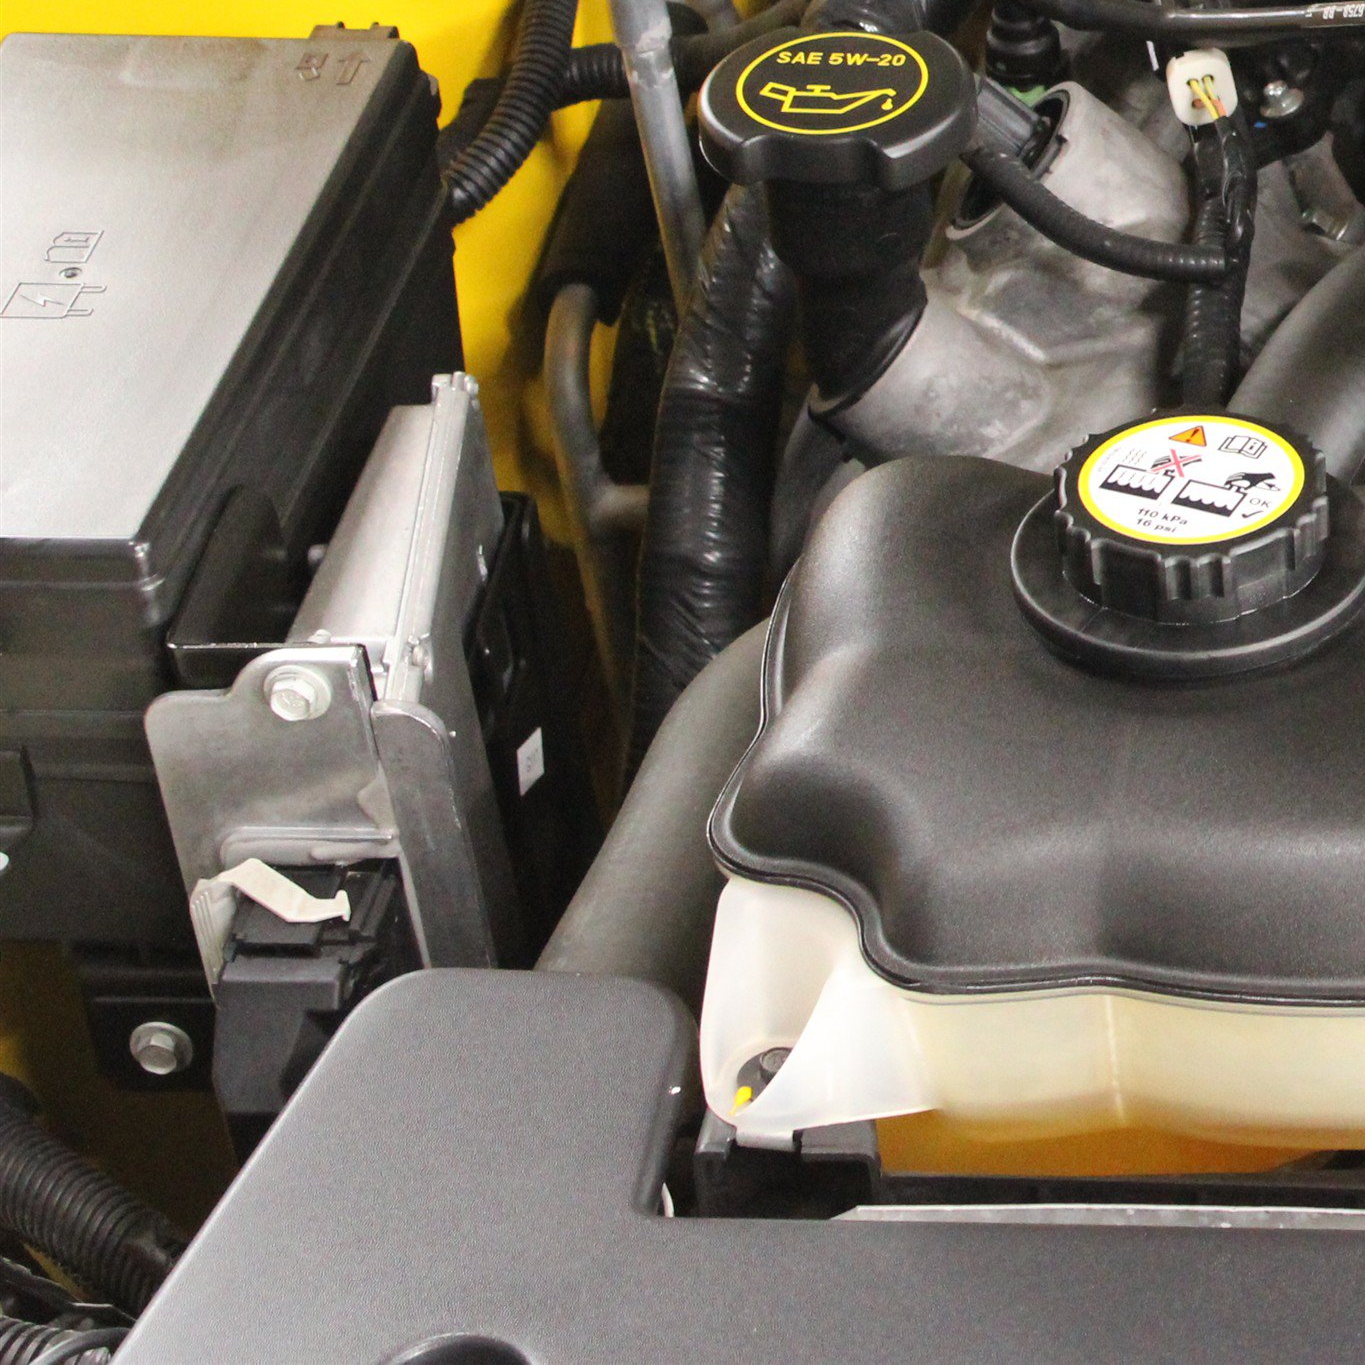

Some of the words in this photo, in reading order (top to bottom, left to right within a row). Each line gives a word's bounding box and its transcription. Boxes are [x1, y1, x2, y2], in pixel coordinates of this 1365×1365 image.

[776, 51, 823, 65] SAE
[828, 51, 907, 67] 5W-20
[1249, 497, 1273, 509] OK
[1137, 507, 1160, 519] 110
[1161, 512, 1189, 526] kPa
[1136, 517, 1152, 527] 16
[1154, 523, 1178, 534] psi
